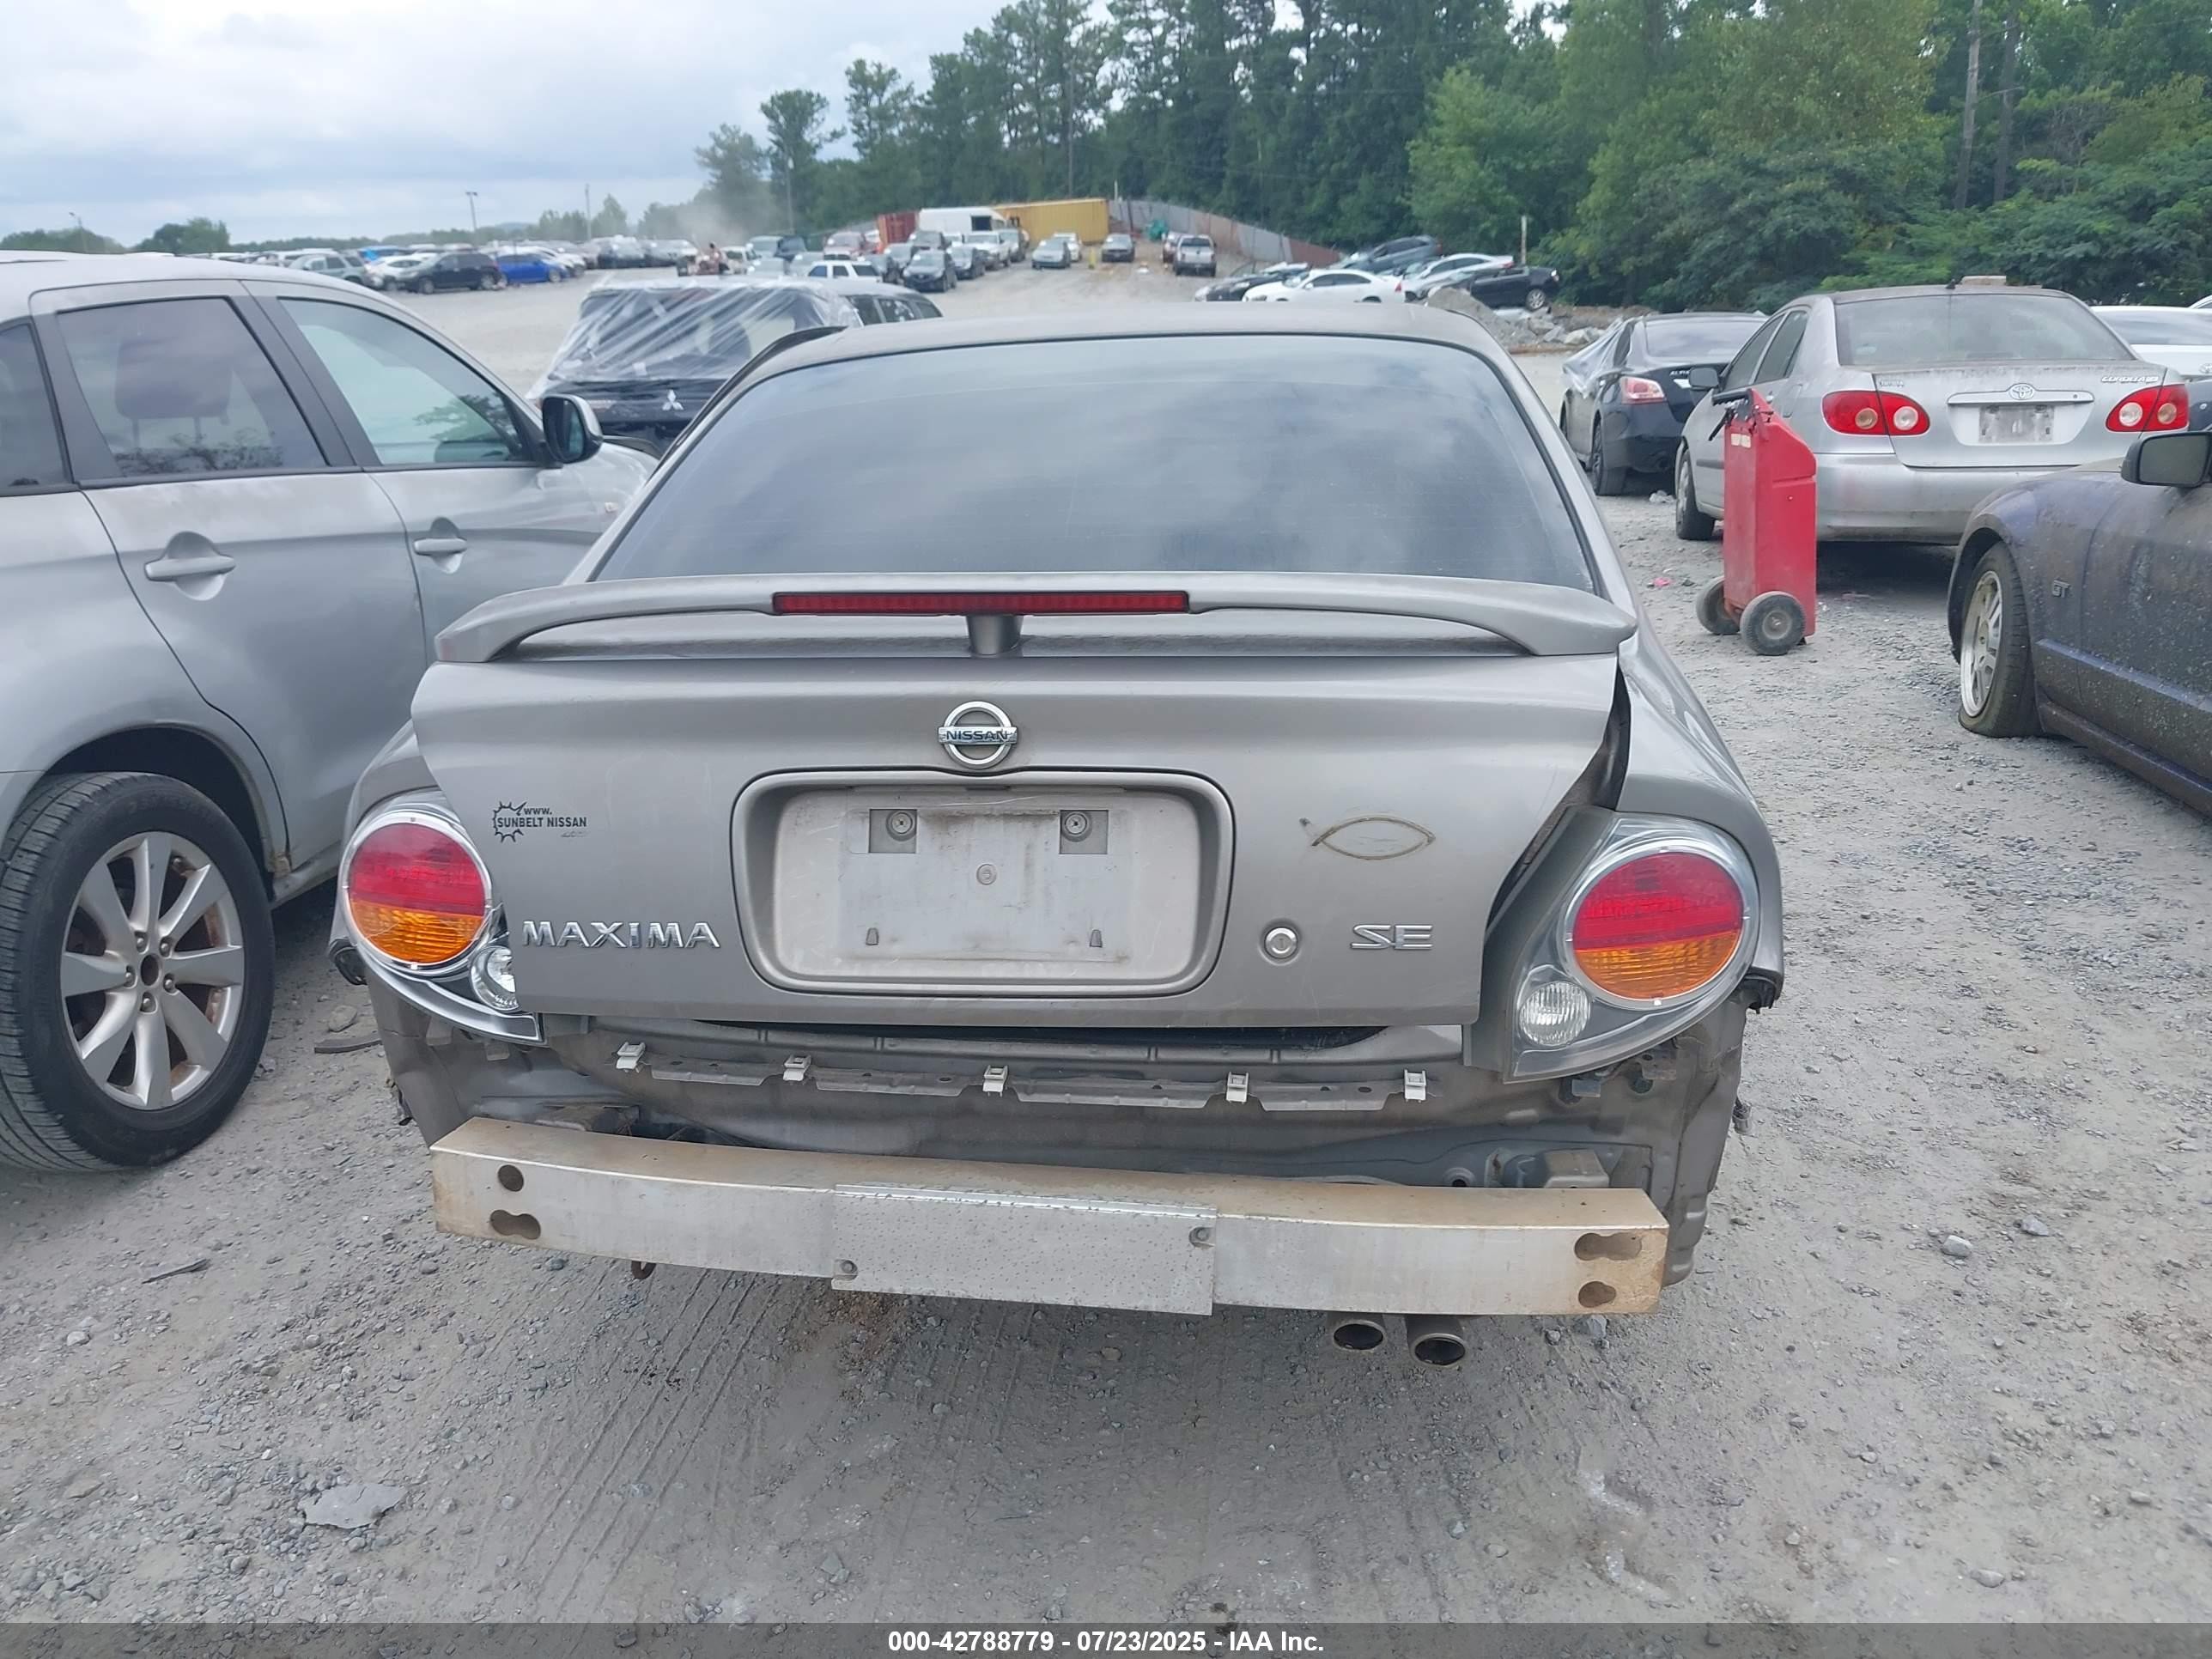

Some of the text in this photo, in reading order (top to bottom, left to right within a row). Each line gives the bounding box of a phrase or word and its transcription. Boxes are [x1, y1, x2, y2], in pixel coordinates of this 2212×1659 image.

[2051, 580, 2071, 599] GT
[946, 730, 1008, 741] NISSAN
[496, 817, 587, 828] SUNBELT NISSAN
[522, 921, 720, 949] MAXIMA
[1350, 923, 1433, 951] SE
